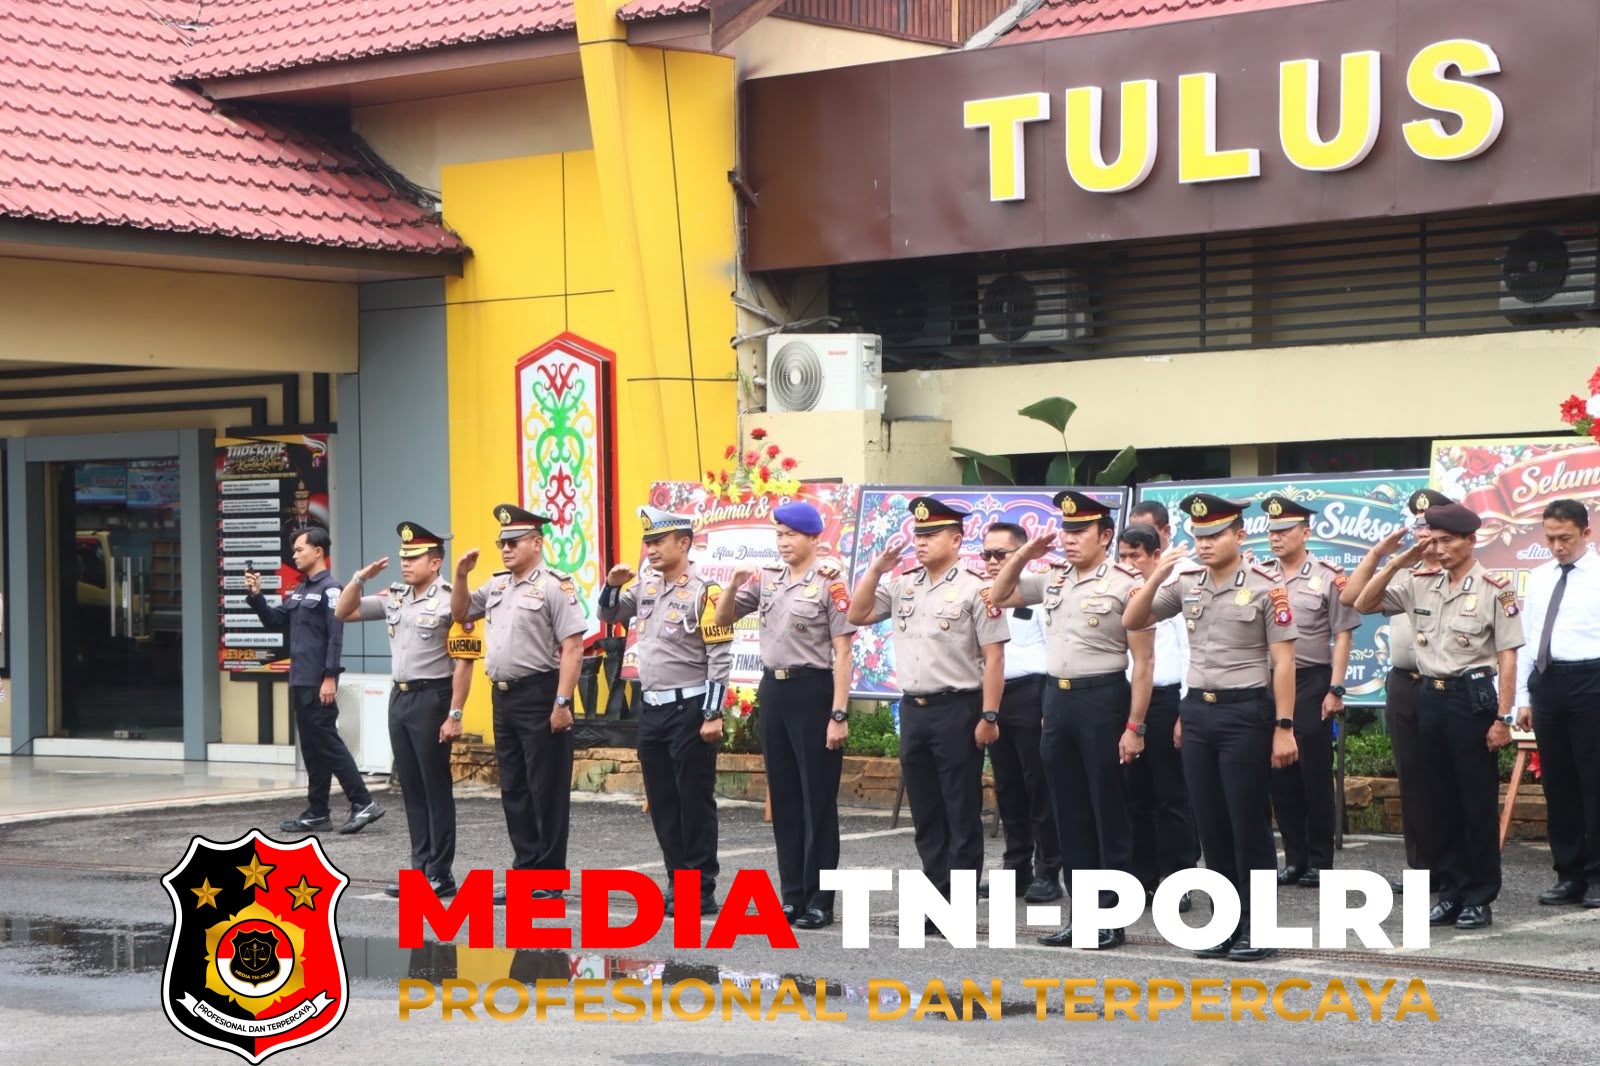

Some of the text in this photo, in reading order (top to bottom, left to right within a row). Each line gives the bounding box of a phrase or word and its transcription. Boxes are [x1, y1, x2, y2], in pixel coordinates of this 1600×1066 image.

[963, 38, 1504, 202] TULUS
[693, 496, 756, 533] Selamat
[757, 495, 771, 519] &
[668, 602, 688, 611] POLRI
